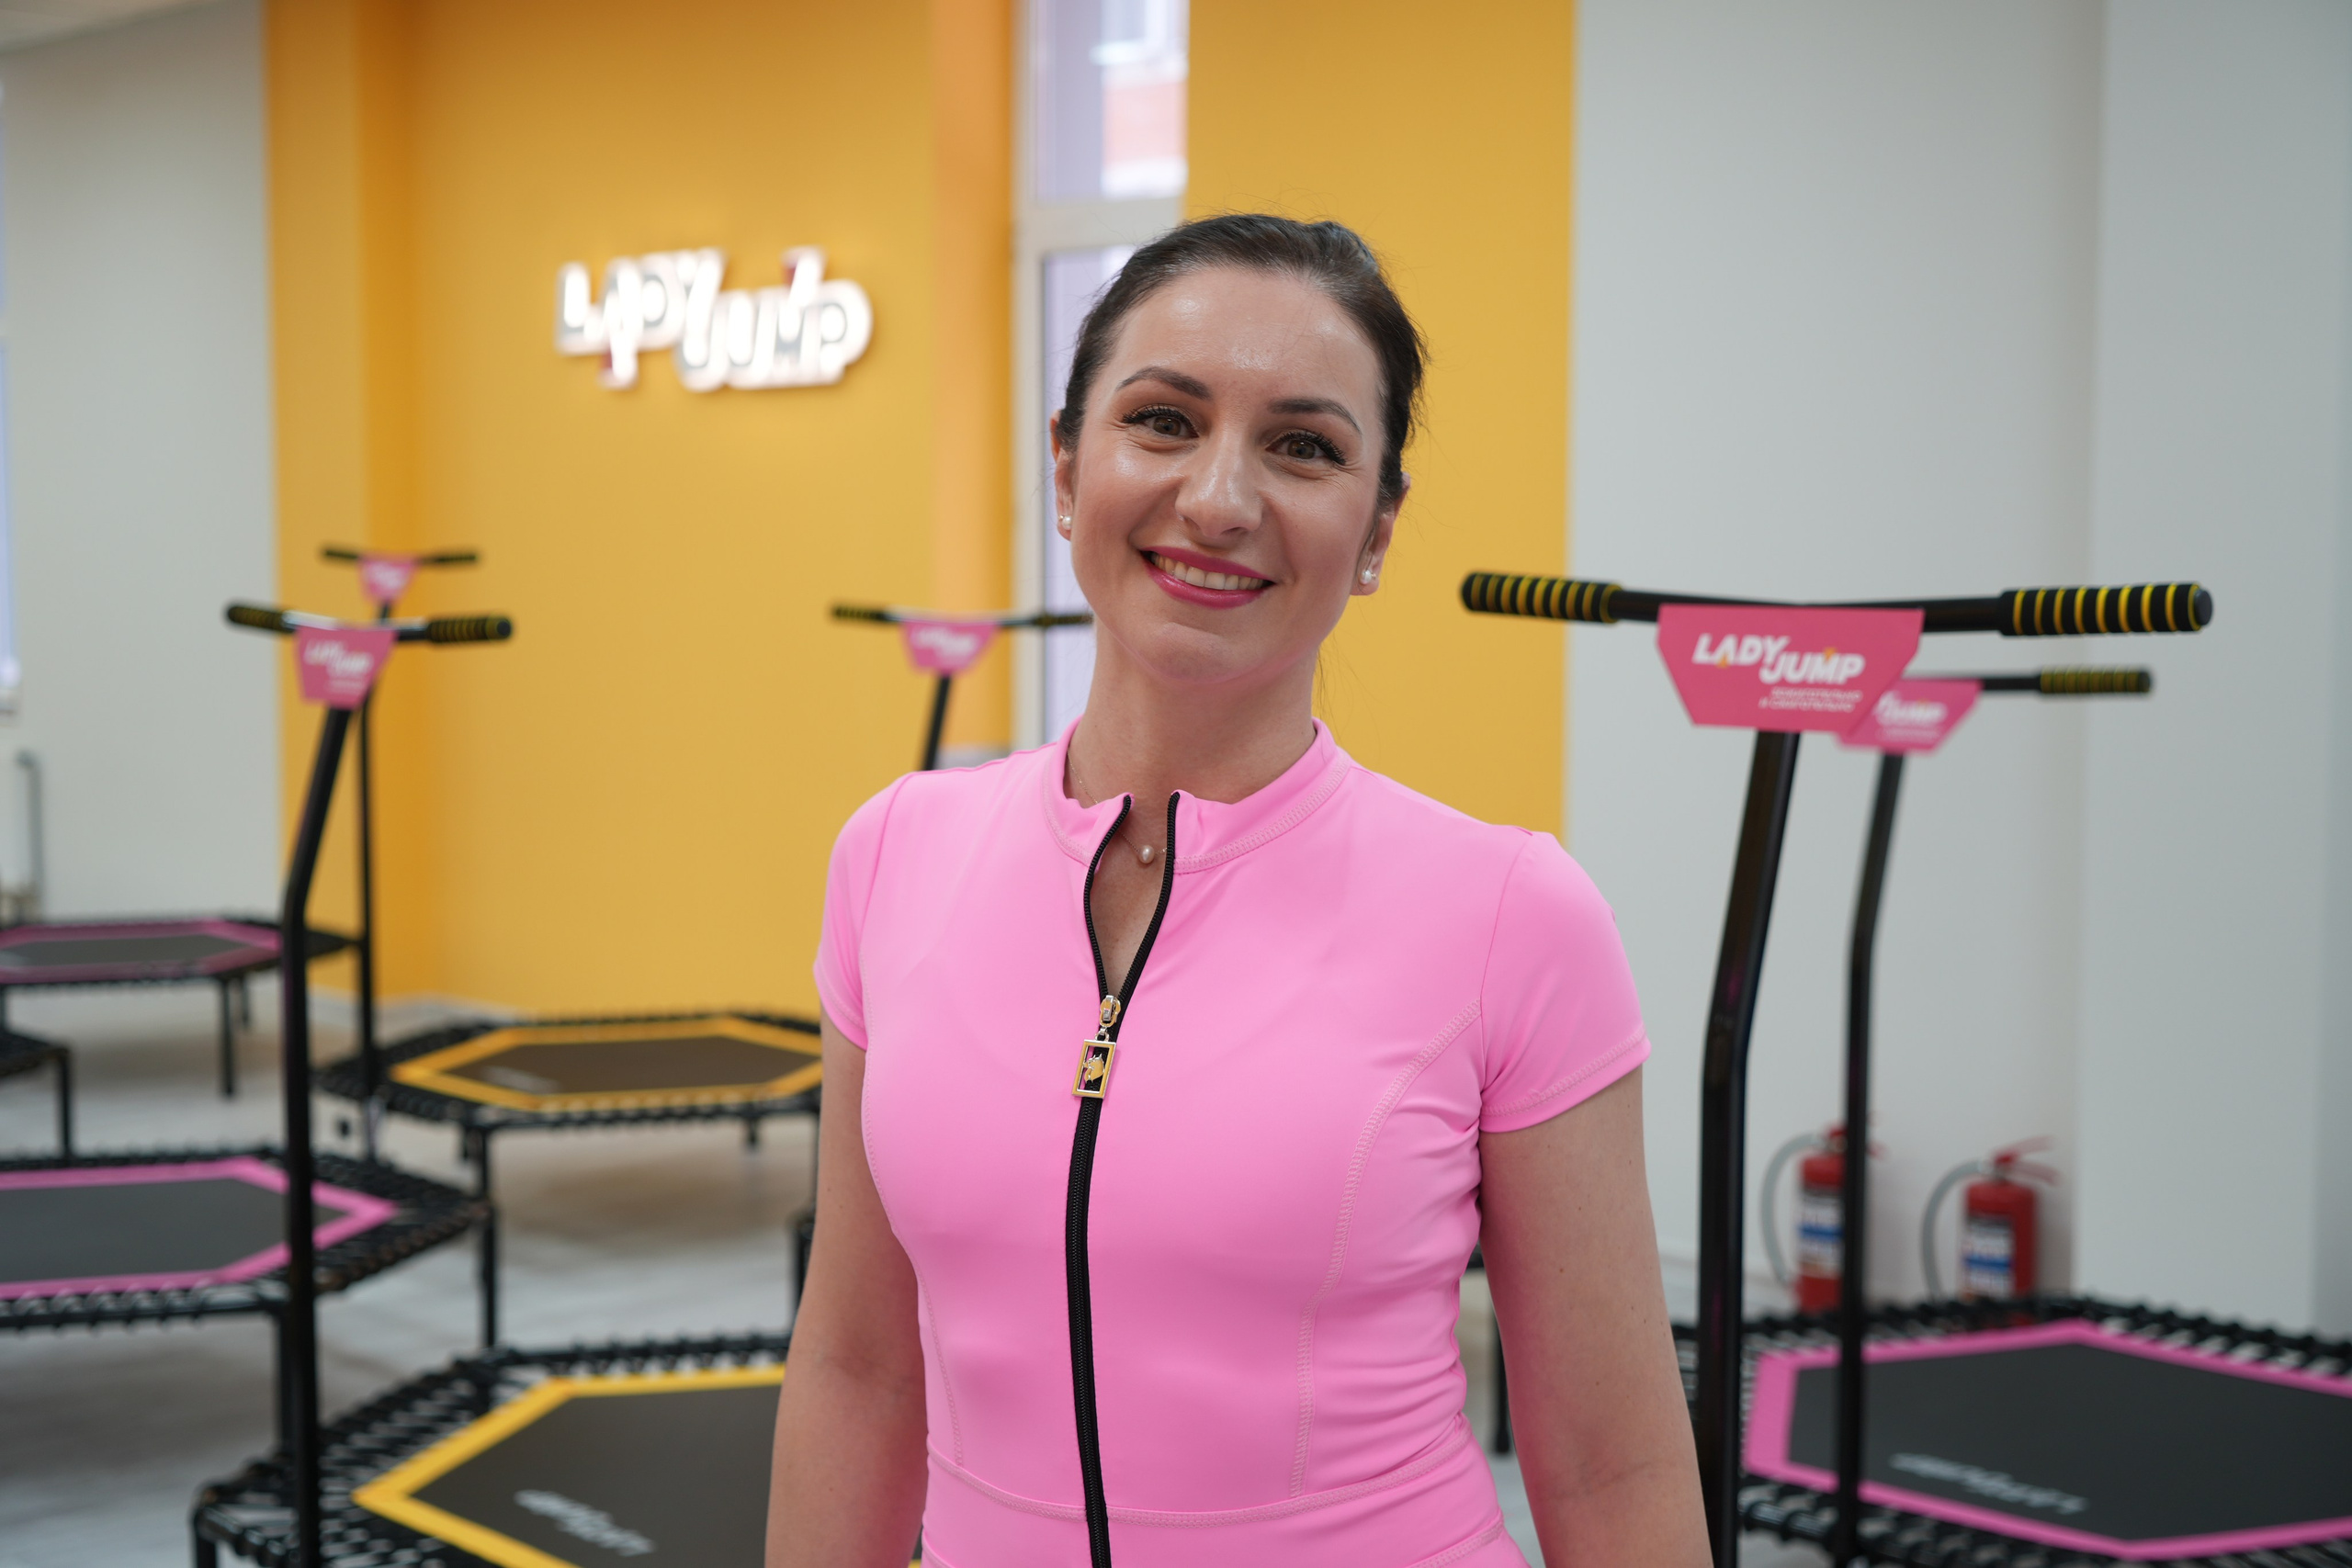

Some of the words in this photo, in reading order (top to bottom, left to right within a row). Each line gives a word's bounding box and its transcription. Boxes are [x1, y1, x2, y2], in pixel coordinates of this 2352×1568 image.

[556, 246, 728, 389] LADY
[673, 245, 873, 393] JUMP
[1691, 632, 1791, 668] LADY
[1758, 648, 1866, 685] JUMP
